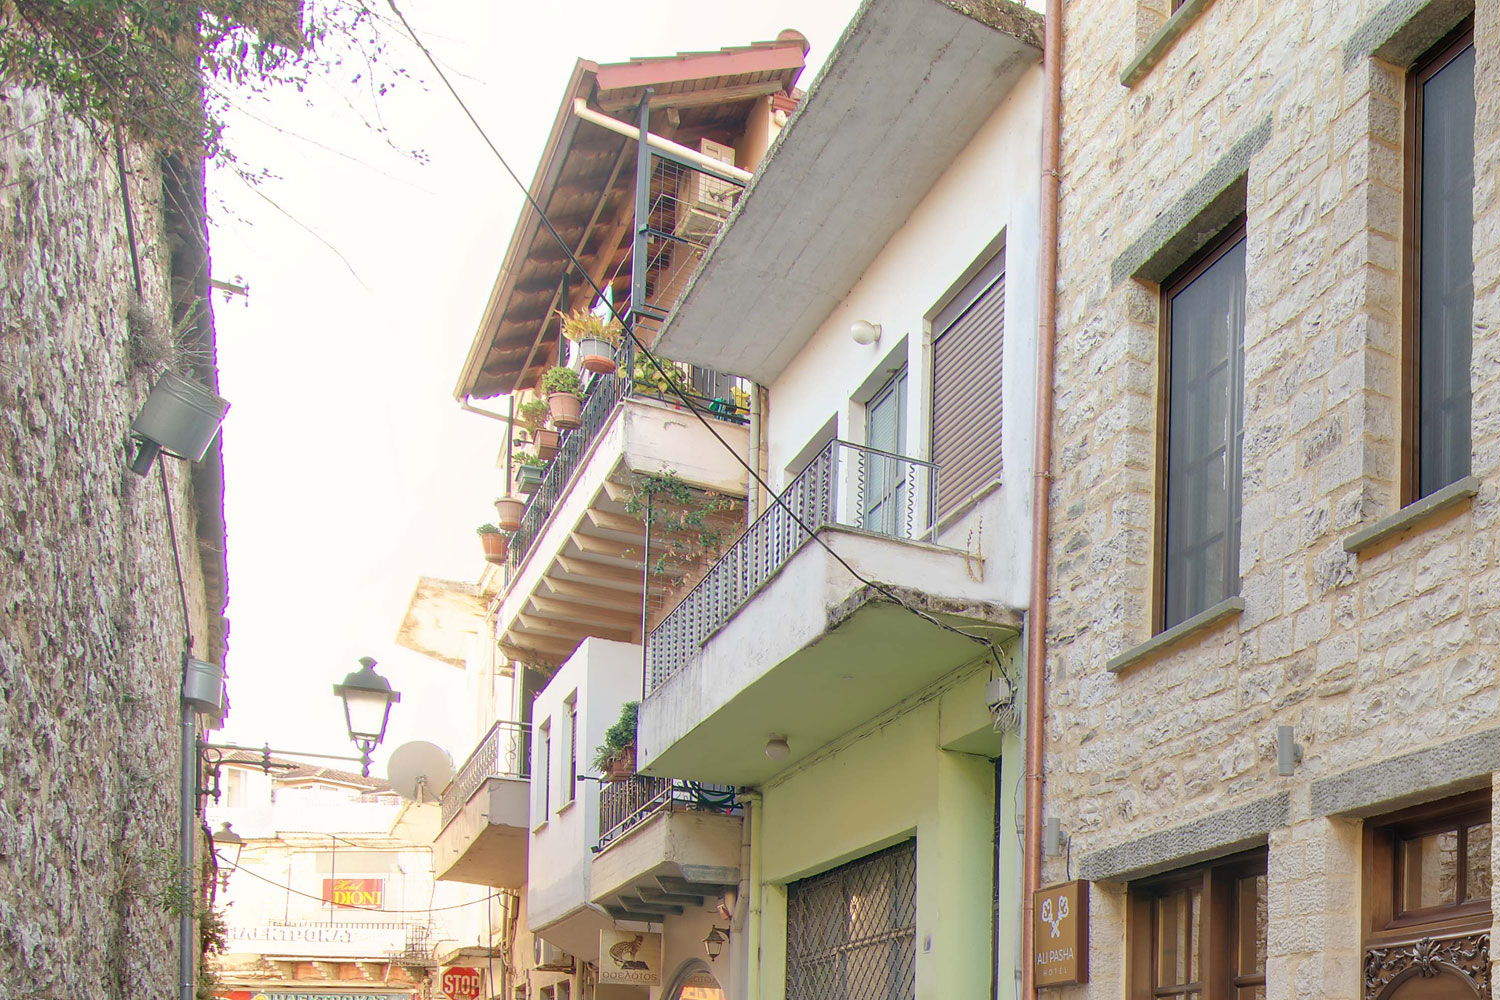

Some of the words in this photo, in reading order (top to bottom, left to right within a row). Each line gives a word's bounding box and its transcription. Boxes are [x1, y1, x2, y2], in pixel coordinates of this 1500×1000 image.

[334, 879, 363, 891] Hotel
[334, 891, 382, 905] DIONI
[1037, 951, 1048, 965] ALI
[1049, 947, 1074, 963] PASHA
[1042, 967, 1067, 976] HOTEL
[444, 974, 479, 995] STOP
